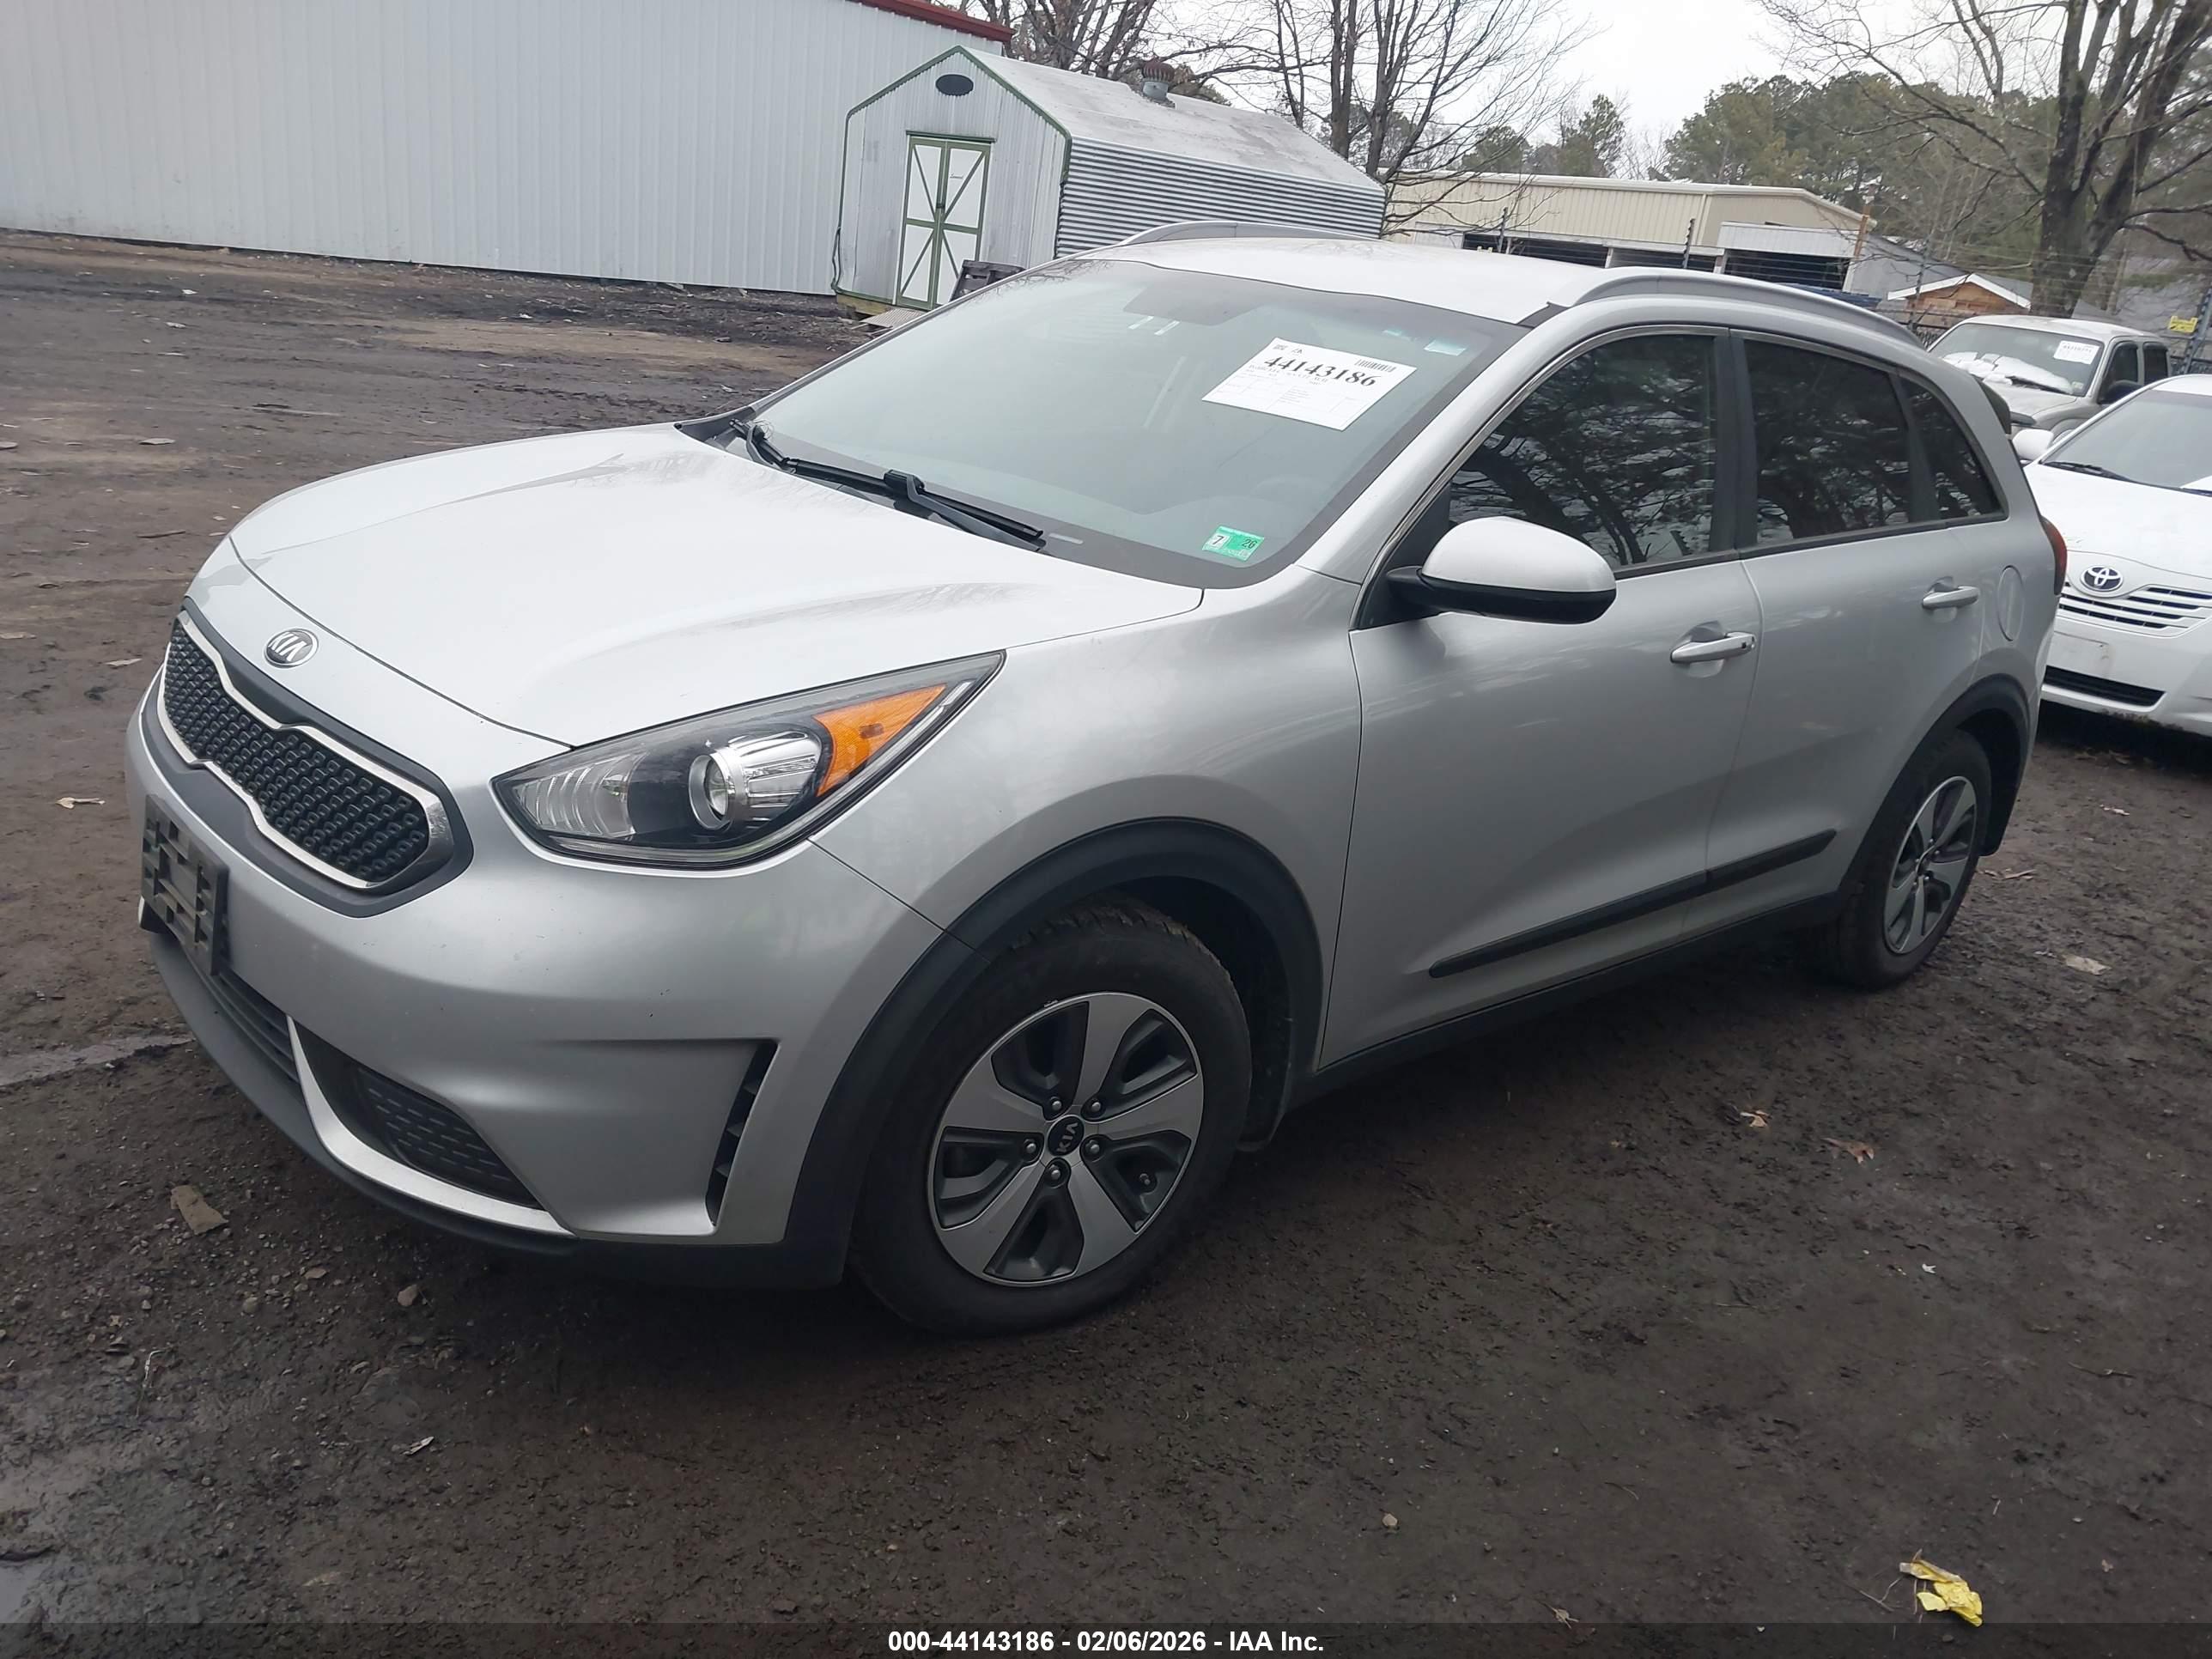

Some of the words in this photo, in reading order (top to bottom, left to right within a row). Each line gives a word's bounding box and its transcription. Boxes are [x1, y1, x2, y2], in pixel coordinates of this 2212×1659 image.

[1264, 356, 1381, 386] 44143186
[1212, 535, 1224, 545] 7
[1056, 1121, 1079, 1153] KIA
